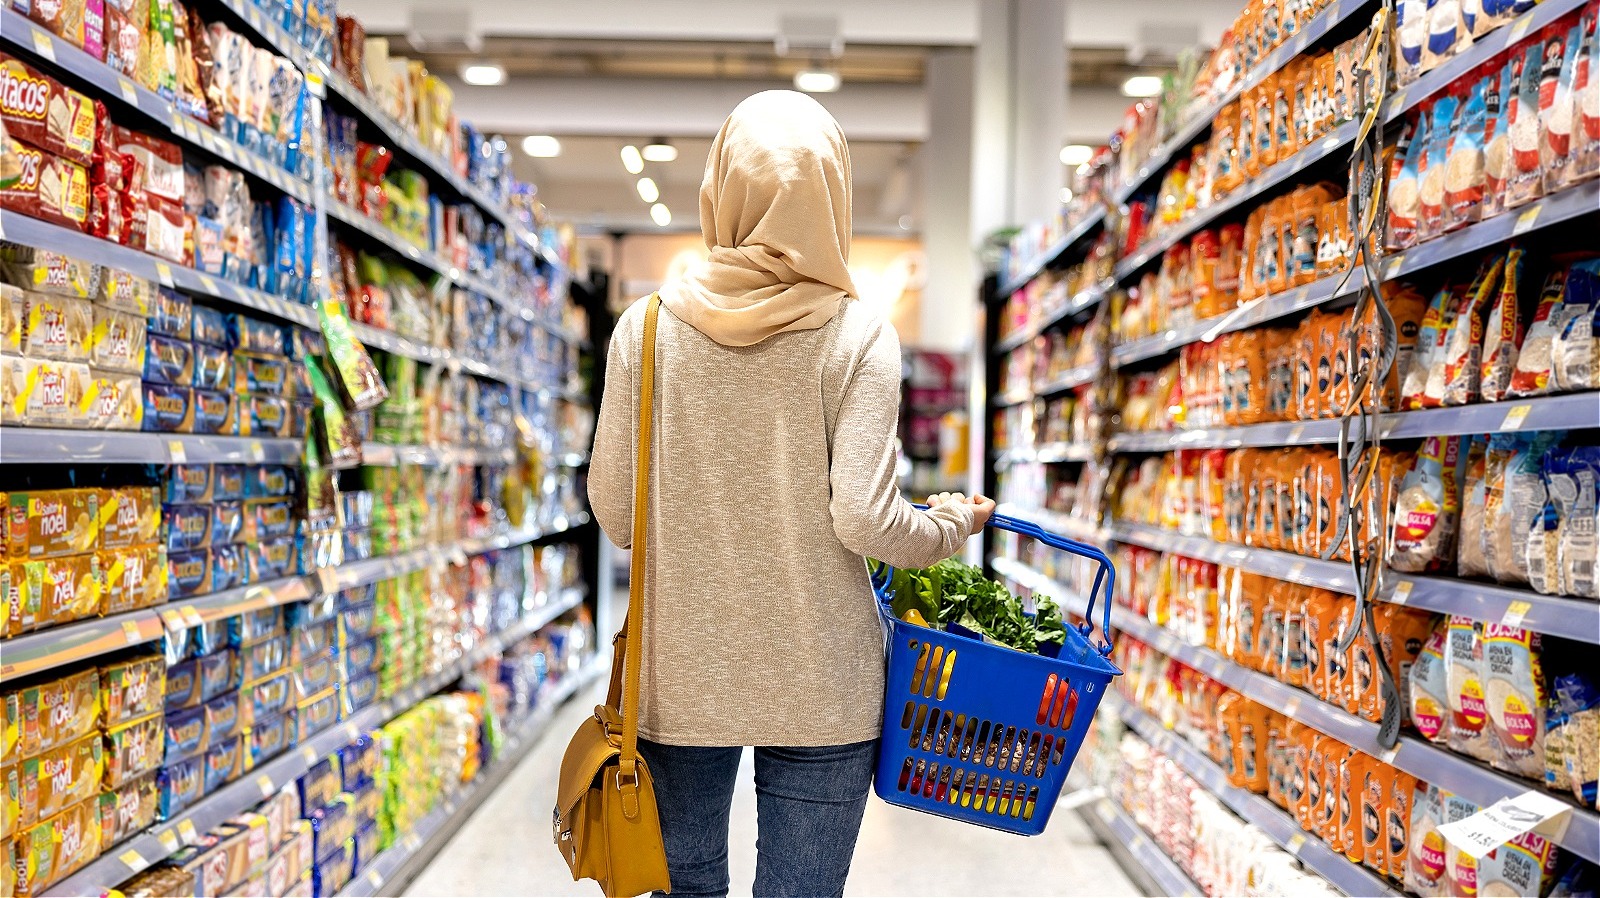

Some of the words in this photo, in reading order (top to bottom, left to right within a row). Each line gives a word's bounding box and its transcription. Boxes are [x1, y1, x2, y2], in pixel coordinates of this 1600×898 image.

[1470, 311, 1482, 341] GRA
[1503, 295, 1515, 338] GRATIS
[43, 375, 65, 405] noel
[41, 505, 67, 536] noel
[117, 498, 138, 526] noel
[1408, 513, 1431, 527] BOLSA
[10, 586, 20, 620] noel
[50, 691, 75, 727] noel
[1463, 699, 1484, 713] BOLSA
[1505, 716, 1532, 730] BOLSA
[16, 859, 28, 893] noel
